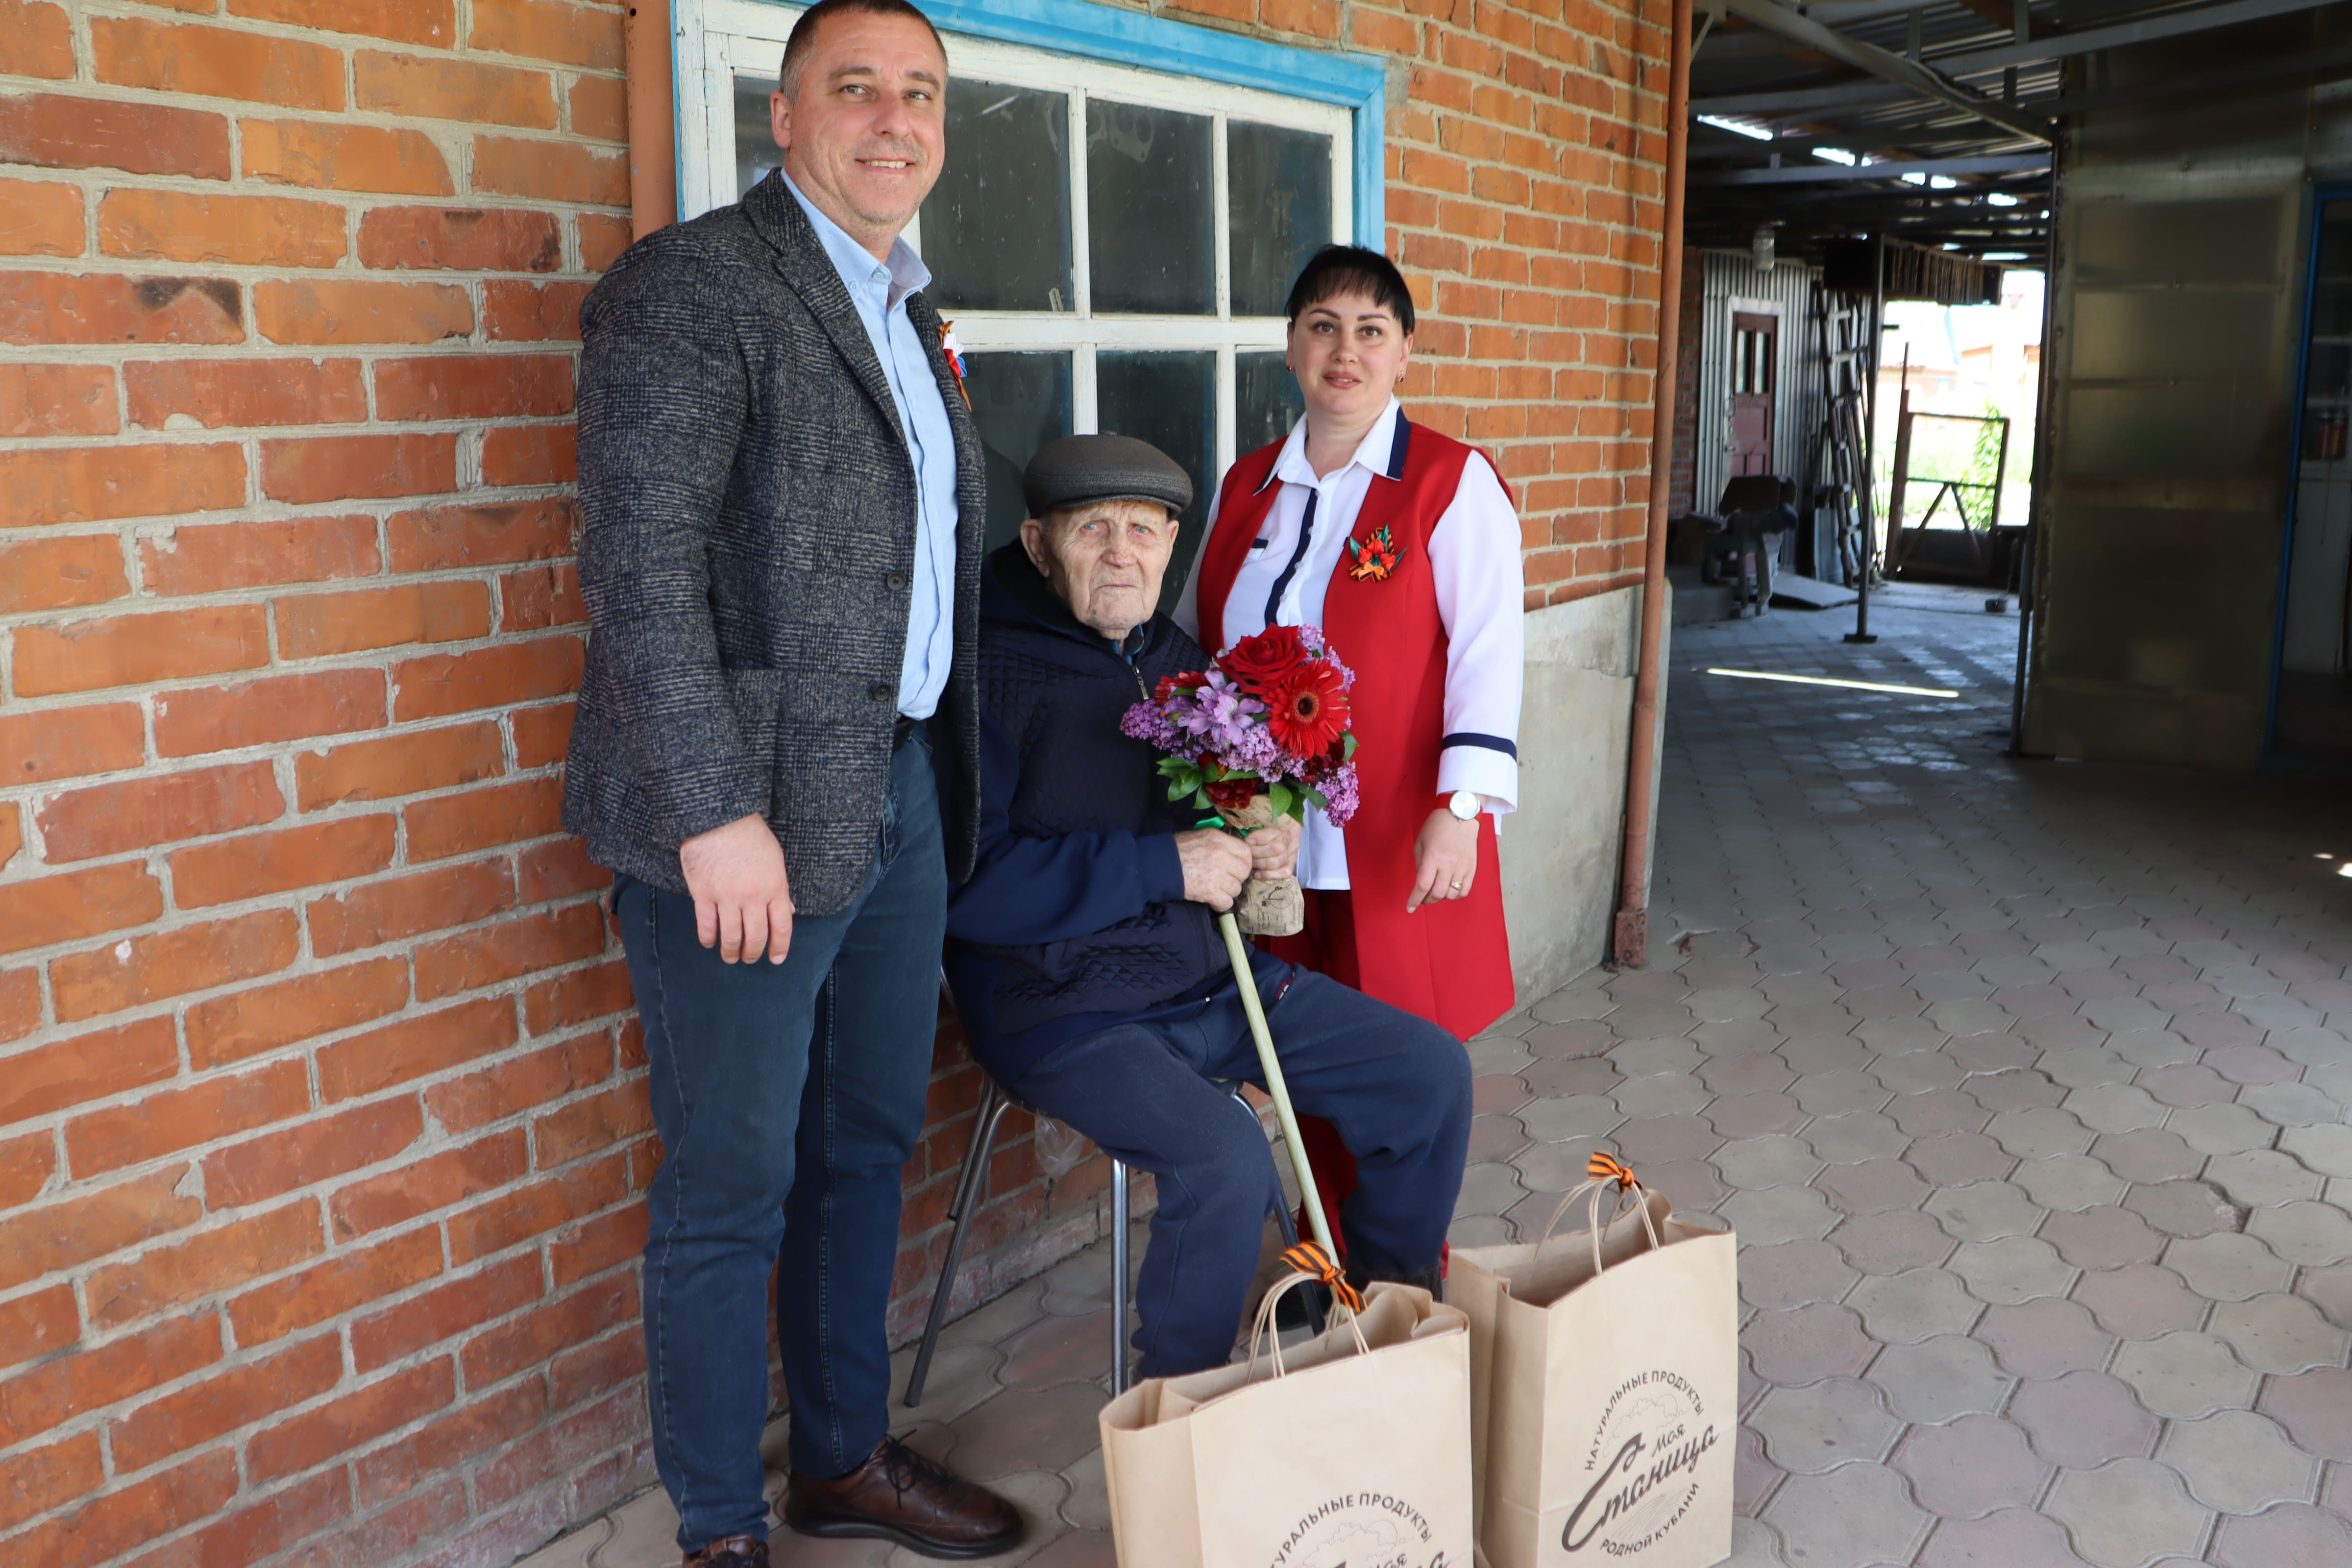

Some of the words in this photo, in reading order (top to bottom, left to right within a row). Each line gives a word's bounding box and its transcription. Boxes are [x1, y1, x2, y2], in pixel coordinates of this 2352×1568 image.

[1584, 1372, 1648, 1471] НАТУРАЛЬНЫЕ
[1651, 1370, 1704, 1417] ПРОДУКТЫ
[1359, 1493, 1432, 1544] ПРОДУКТЫ
[1561, 1424, 1720, 1553] Станица
[1600, 1535, 1652, 1558] РОДНОЙ
[1655, 1483, 1700, 1543] КУБАНИ
